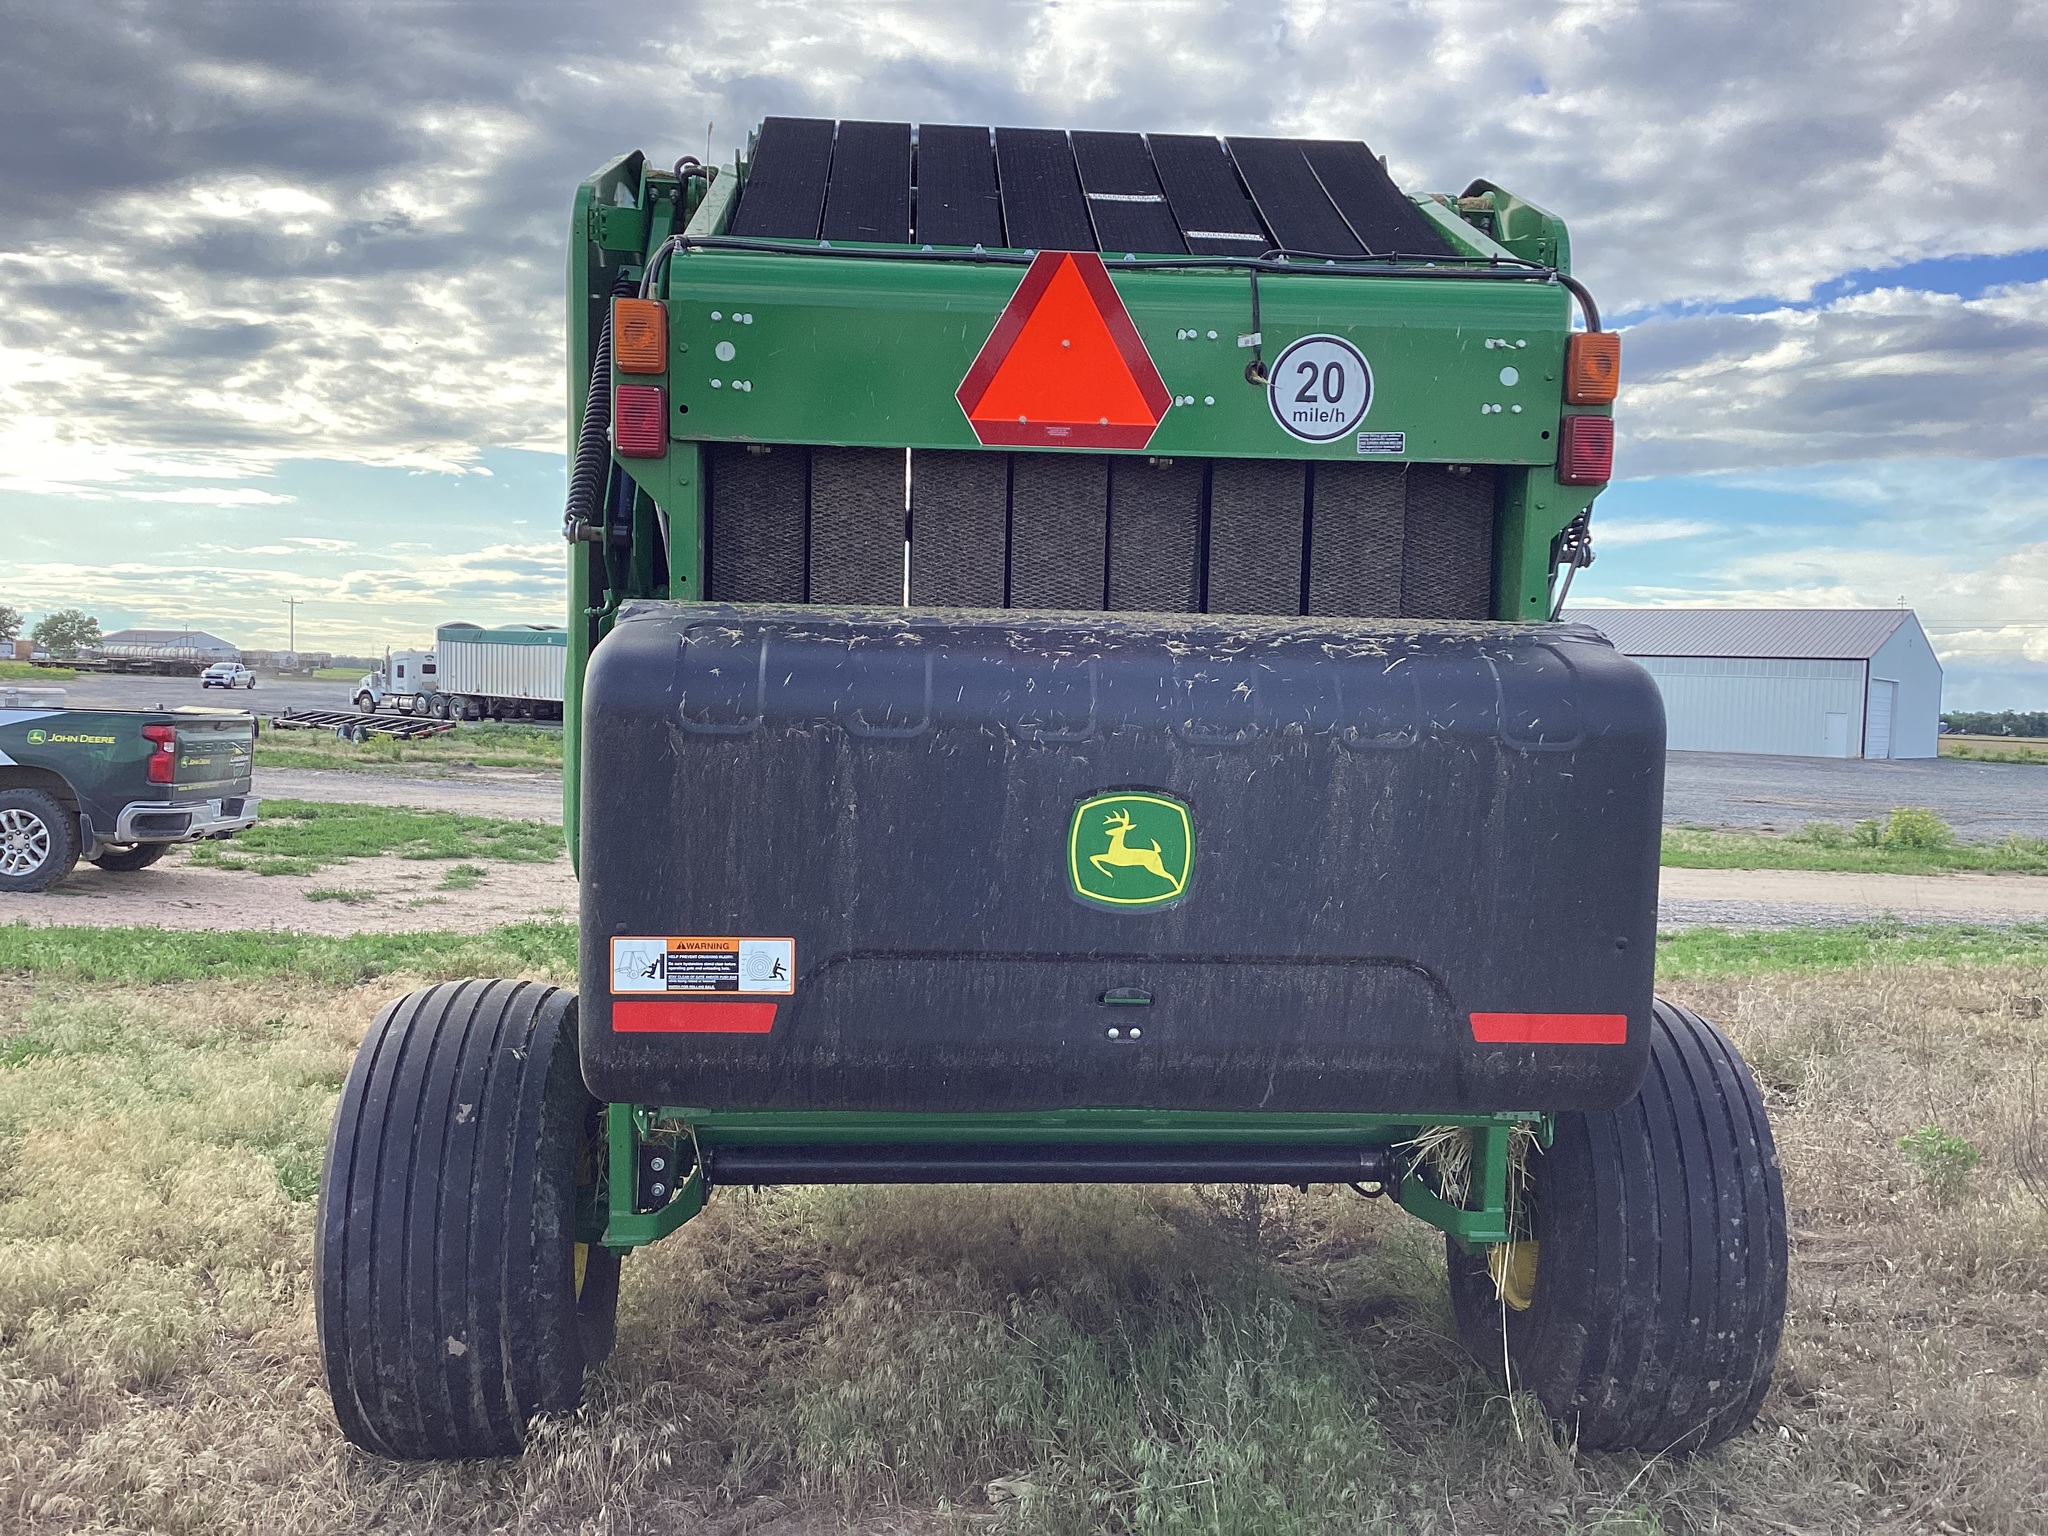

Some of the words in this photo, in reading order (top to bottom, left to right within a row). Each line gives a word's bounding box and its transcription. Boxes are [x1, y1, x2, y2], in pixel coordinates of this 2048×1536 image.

[1294, 361, 1345, 403] 20
[1293, 408, 1345, 422] mile/h
[48, 733, 78, 742] JOHN
[79, 734, 116, 744] DEERE
